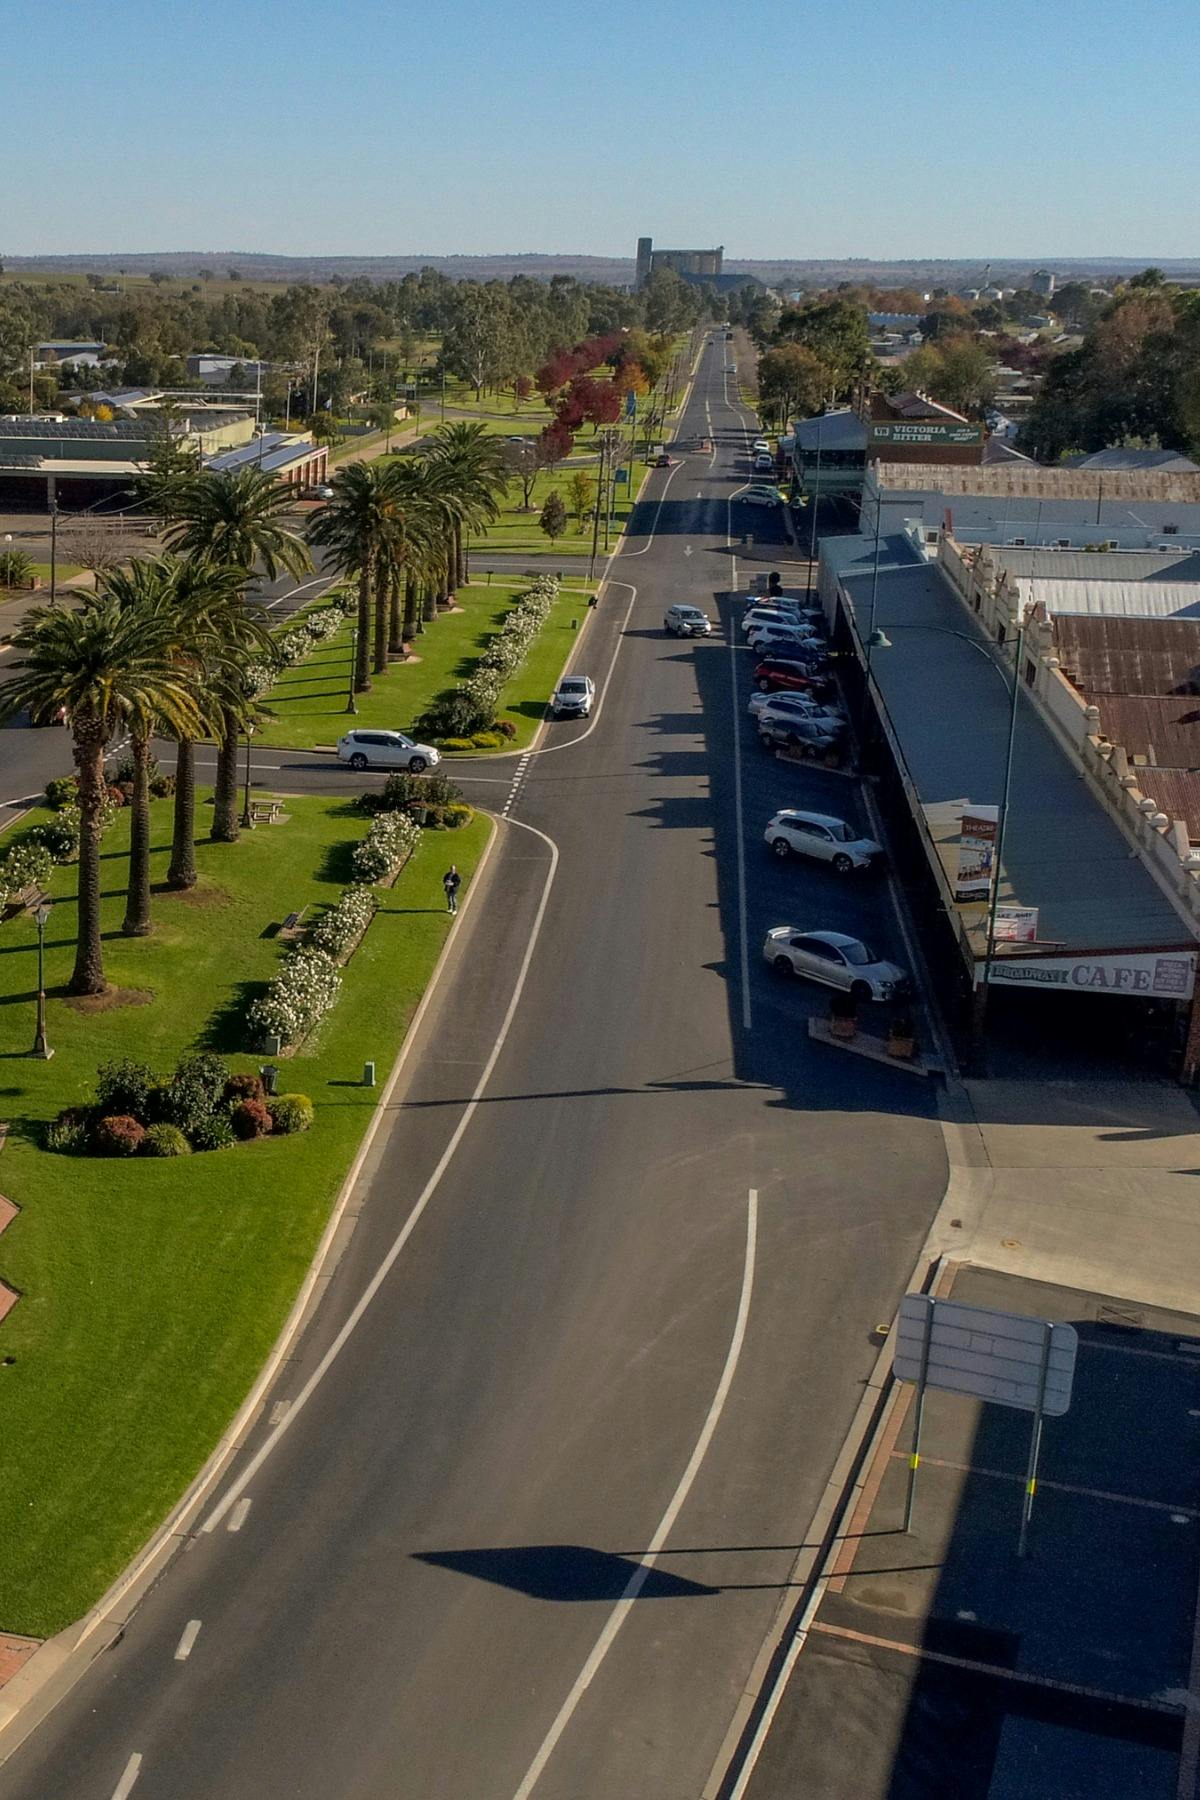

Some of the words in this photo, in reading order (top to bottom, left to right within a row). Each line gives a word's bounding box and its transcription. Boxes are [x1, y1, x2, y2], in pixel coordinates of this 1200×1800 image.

[894, 426, 946, 434] VICTORIA
[893, 433, 932, 441] BITTER
[1071, 965, 1152, 990] CAFE
